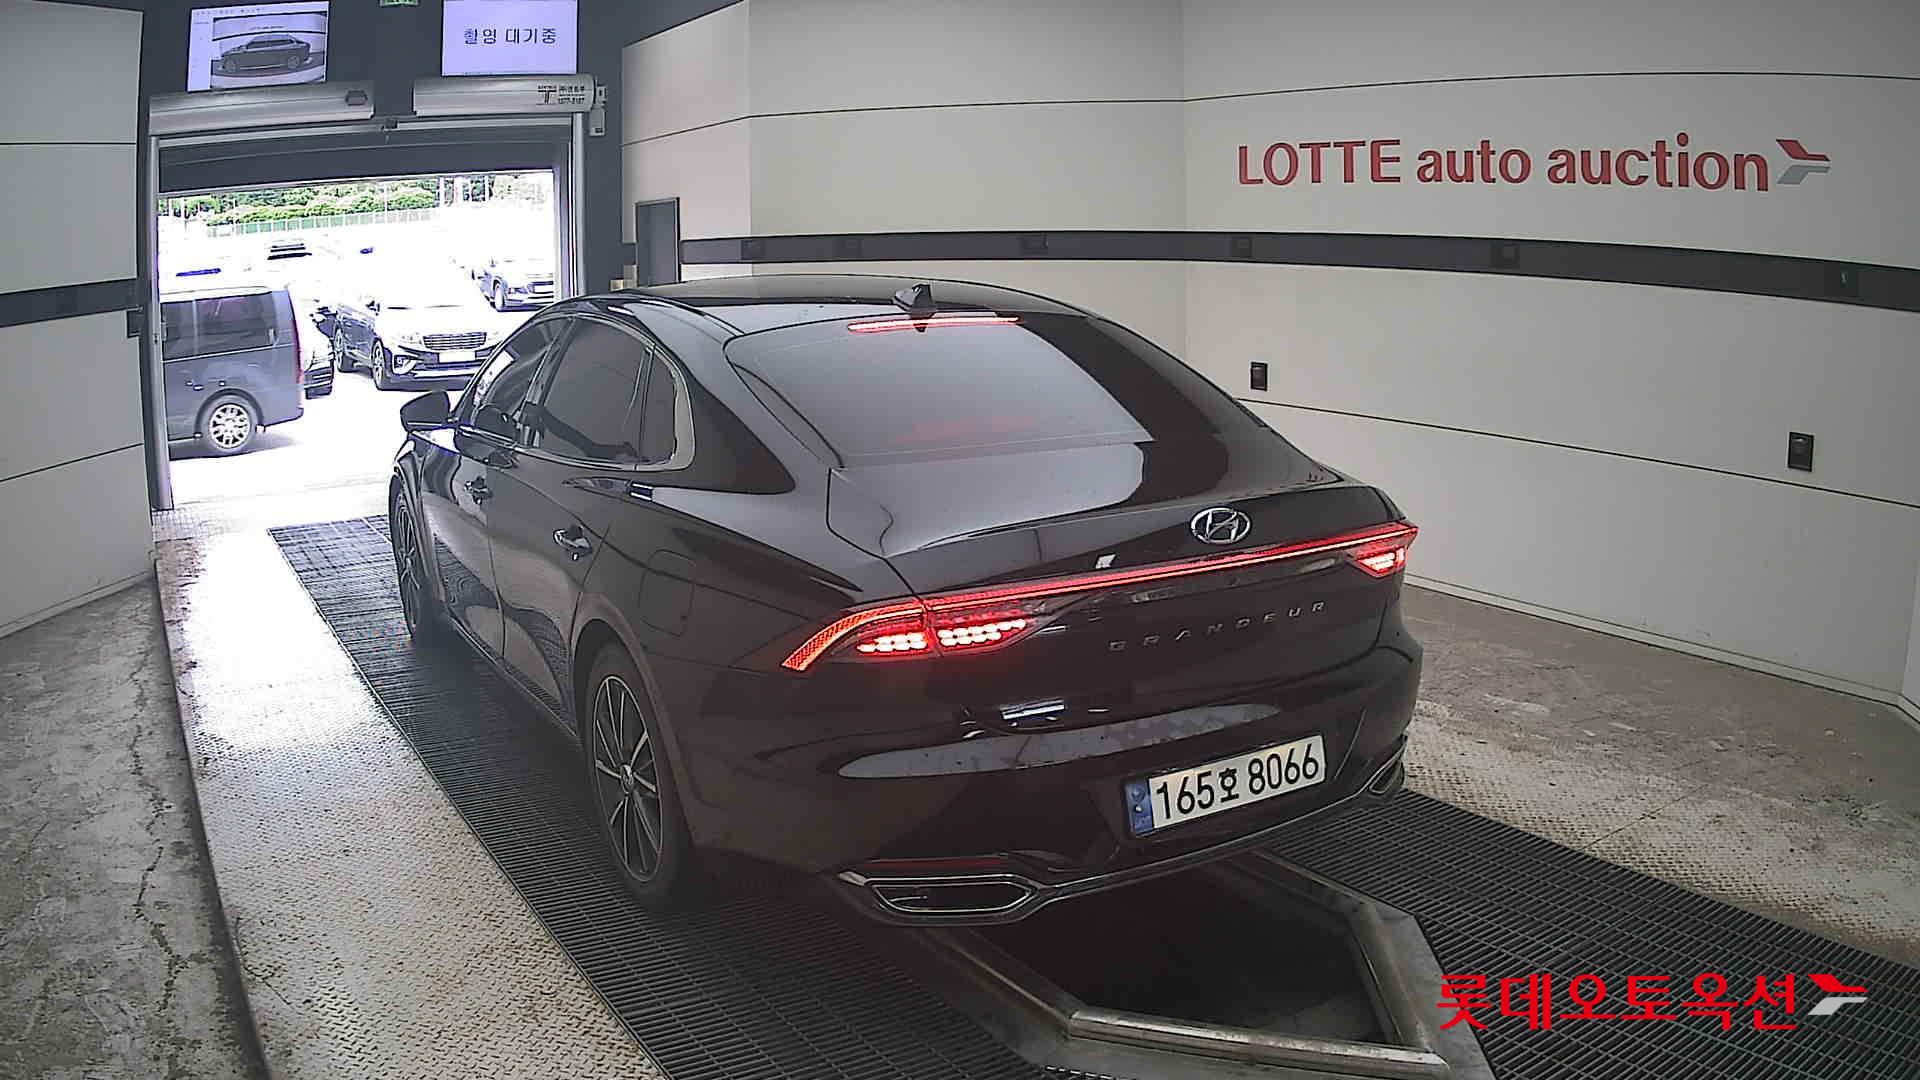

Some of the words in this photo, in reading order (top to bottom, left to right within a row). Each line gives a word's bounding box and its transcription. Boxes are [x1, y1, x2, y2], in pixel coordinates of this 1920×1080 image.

[505, 28, 556, 44] 대기중
[1238, 139, 1401, 185] LOTTE
[1416, 140, 1532, 184] auto
[1547, 132, 1769, 192] auction
[1109, 601, 1325, 650] GRANDEUR
[1156, 768, 1240, 820] 165호
[1248, 743, 1319, 795] 8066
